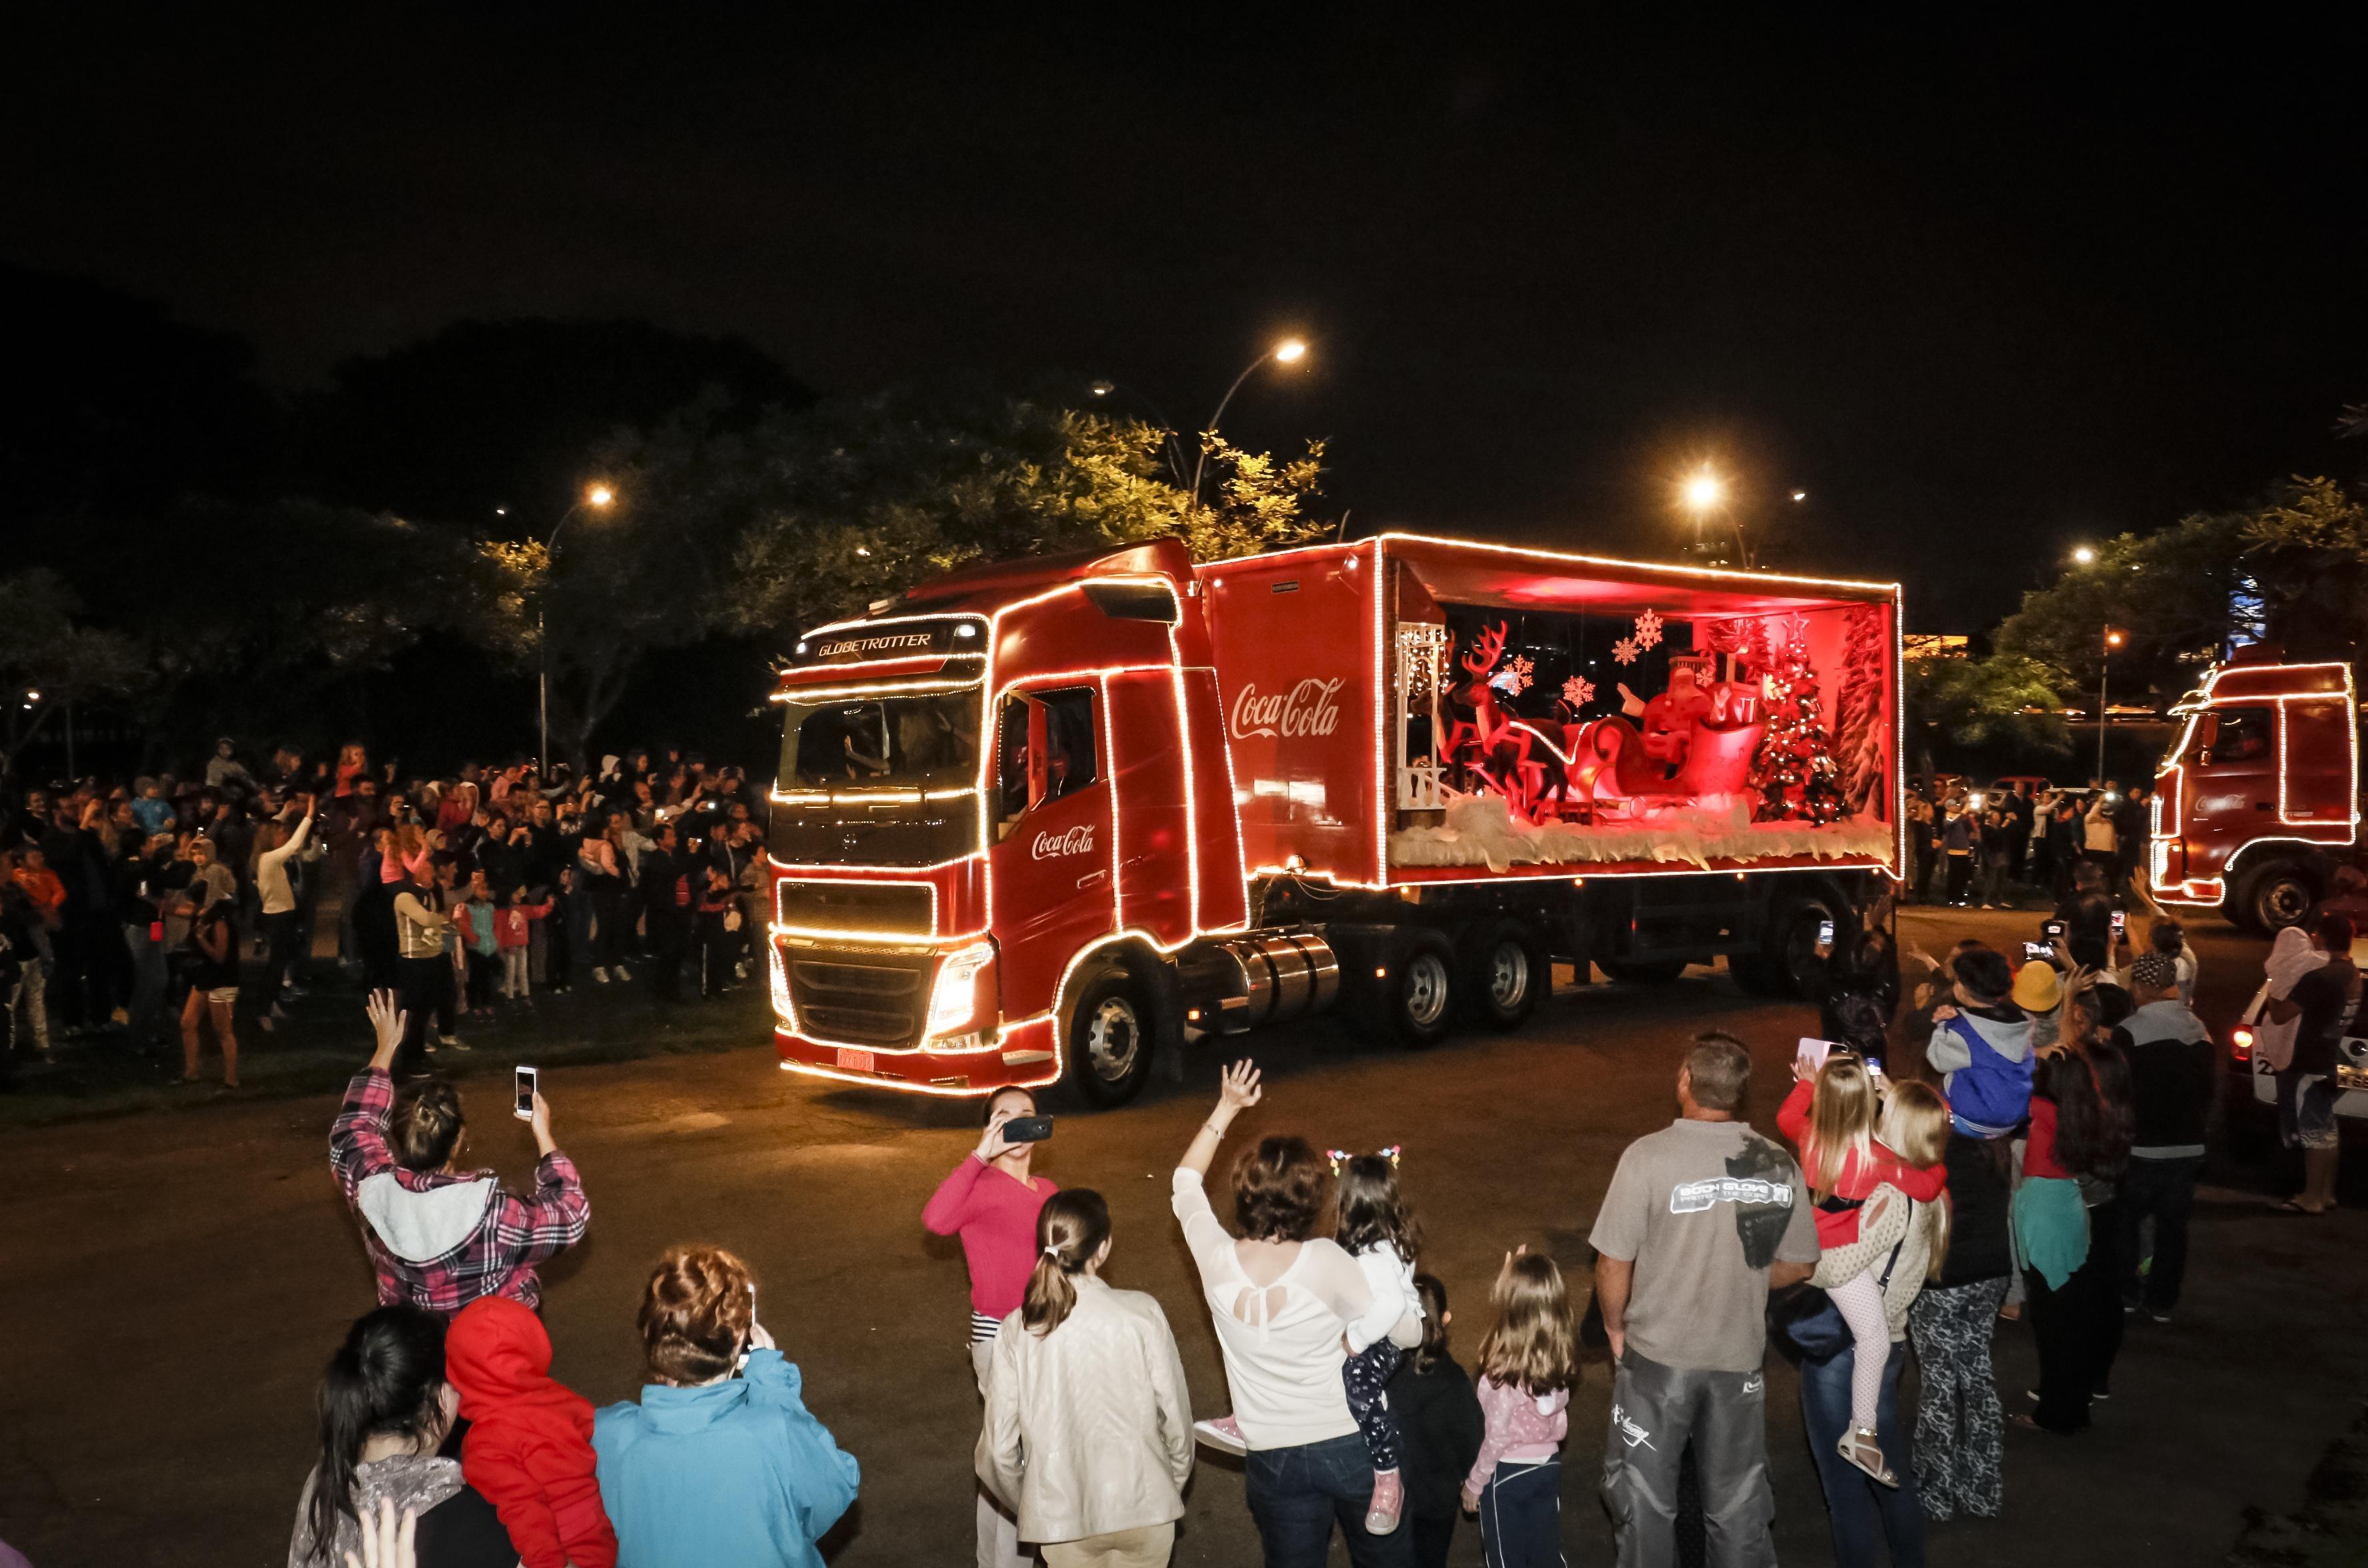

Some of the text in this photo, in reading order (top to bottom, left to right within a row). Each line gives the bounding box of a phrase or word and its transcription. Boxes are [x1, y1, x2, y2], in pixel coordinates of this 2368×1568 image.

[819, 633, 931, 657] GLOBETROTTER
[1231, 677, 1346, 739] Coca-Cola
[2195, 793, 2247, 811] CoCola
[1031, 823, 1095, 861] Coca-Cola
[1722, 1182, 1769, 1194] GLOVE
